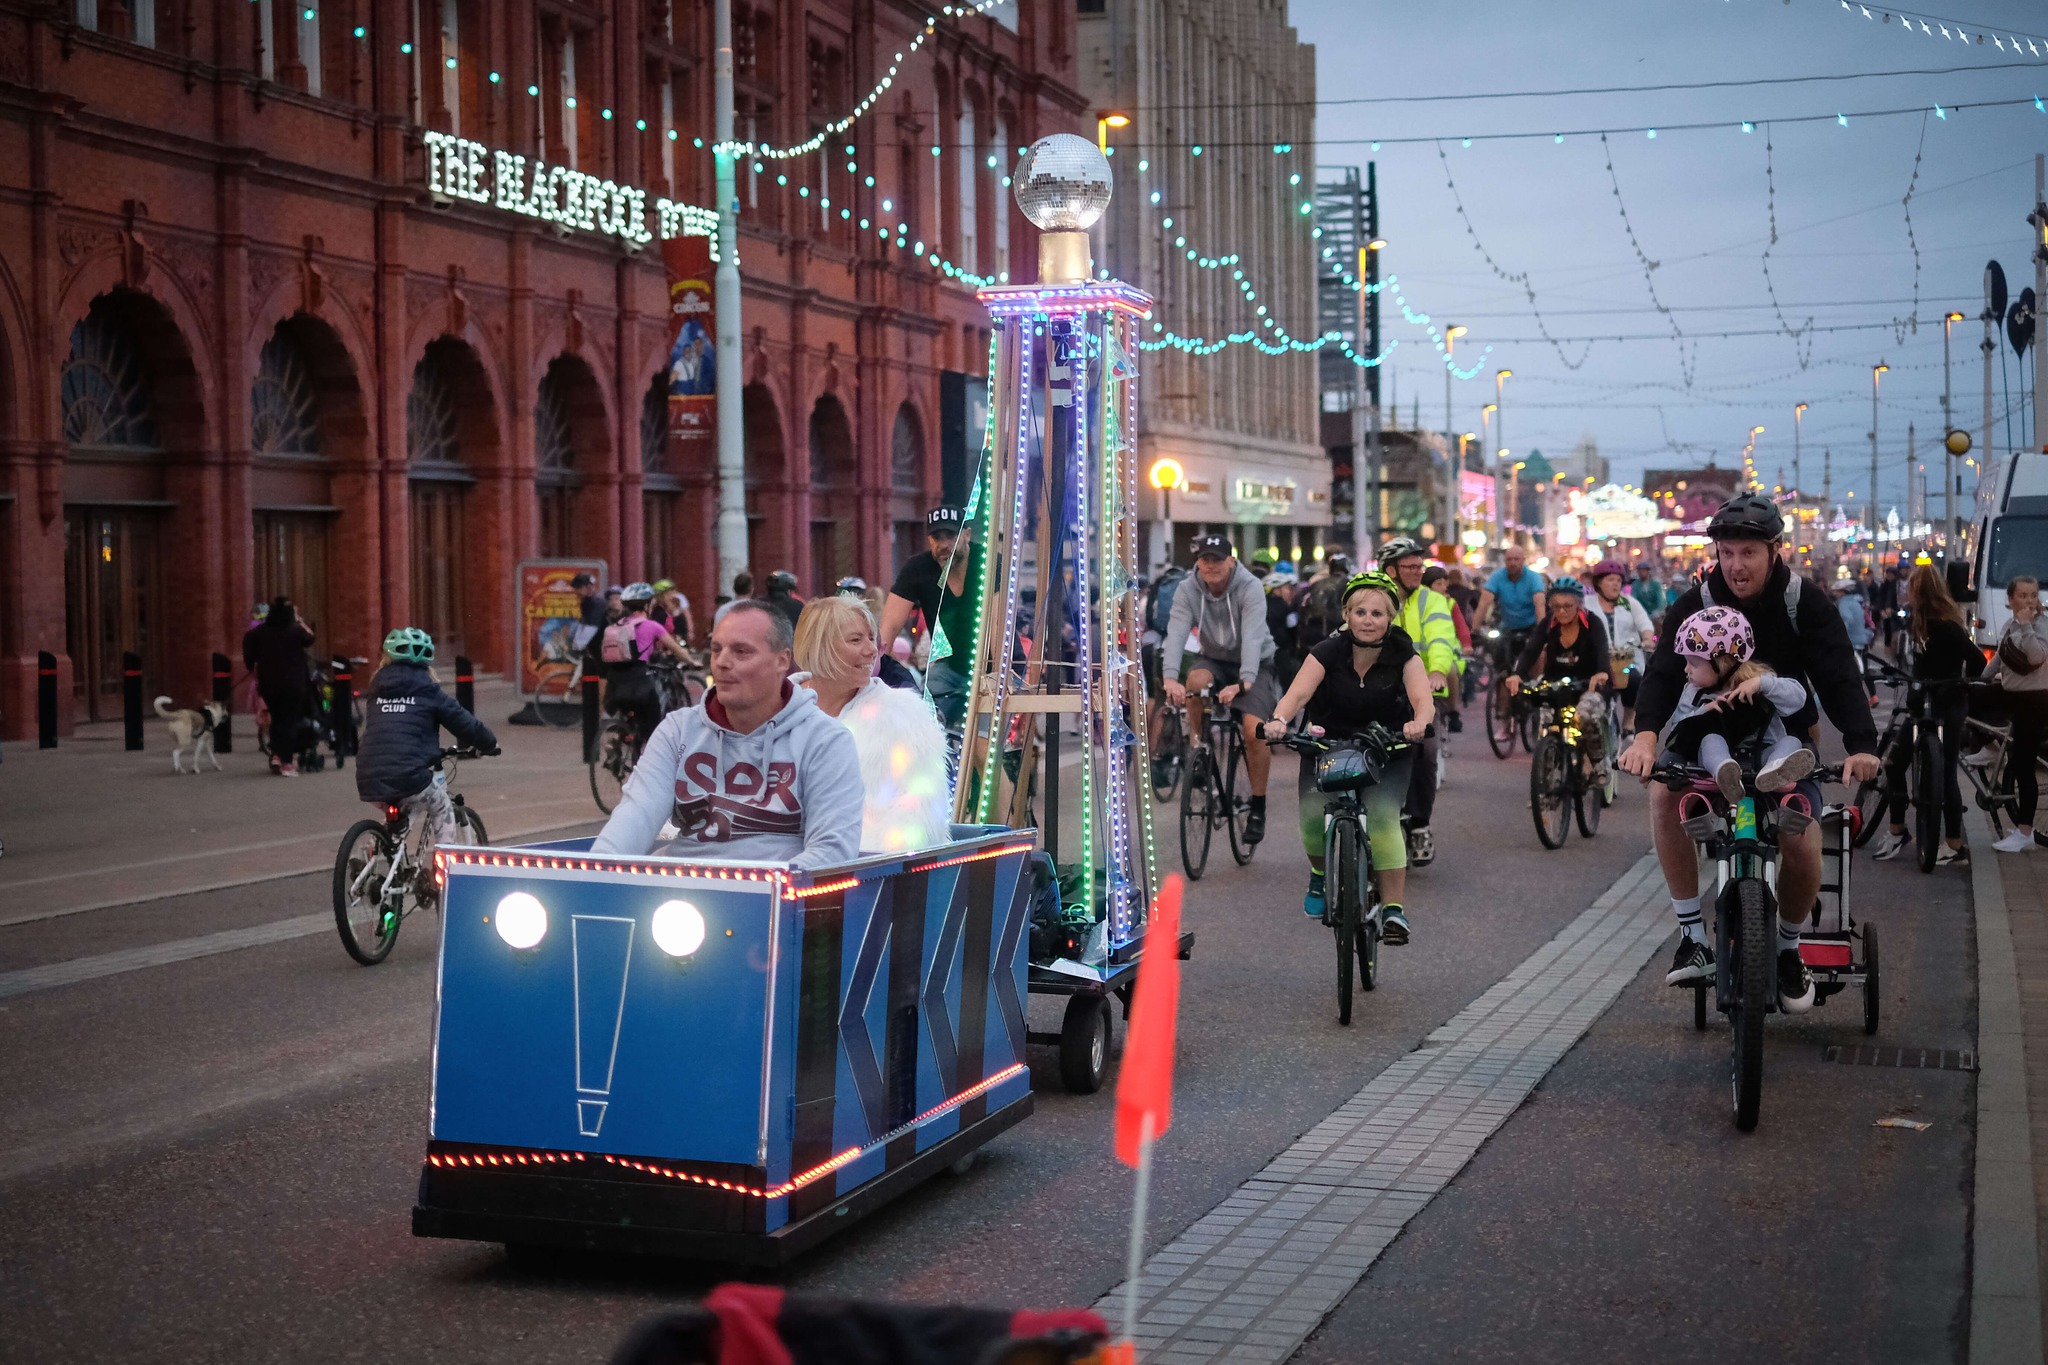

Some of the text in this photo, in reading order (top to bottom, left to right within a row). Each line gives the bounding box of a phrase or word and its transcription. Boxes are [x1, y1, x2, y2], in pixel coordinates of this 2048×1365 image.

[424, 130, 490, 204] THE
[494, 149, 653, 244] BLACKPOOL
[928, 508, 958, 524] ICON
[381, 703, 406, 713] CLUB
